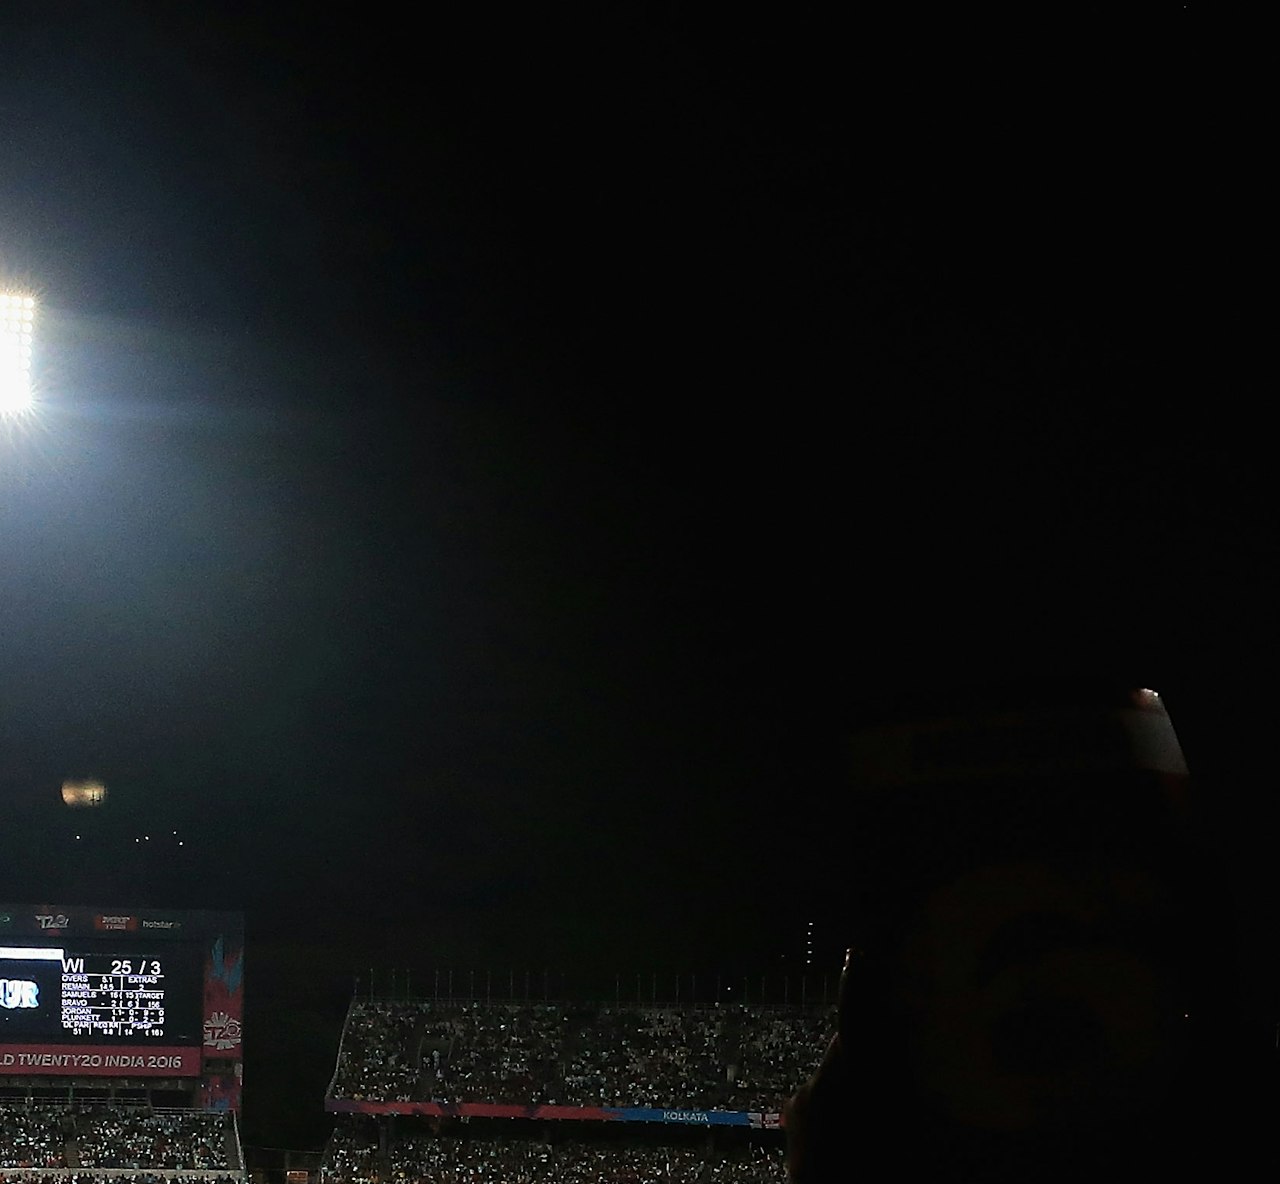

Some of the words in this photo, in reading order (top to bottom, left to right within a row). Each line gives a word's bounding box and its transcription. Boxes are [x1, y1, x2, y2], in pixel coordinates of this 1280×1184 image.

[61, 958, 84, 974] WI
[111, 960, 132, 975] 25
[150, 961, 161, 975] 3
[61, 975, 89, 983] OVERS
[128, 976, 158, 984] EXTRAS
[61, 991, 97, 999] SAMUELS
[139, 992, 165, 1000] TARGET
[61, 1014, 101, 1022] PLUNKETT
[18, 1053, 102, 1068] TWENTY20
[104, 1054, 145, 1068] INDIA
[147, 1055, 182, 1069] 2016
[663, 1111, 709, 1122] KOLKATA
